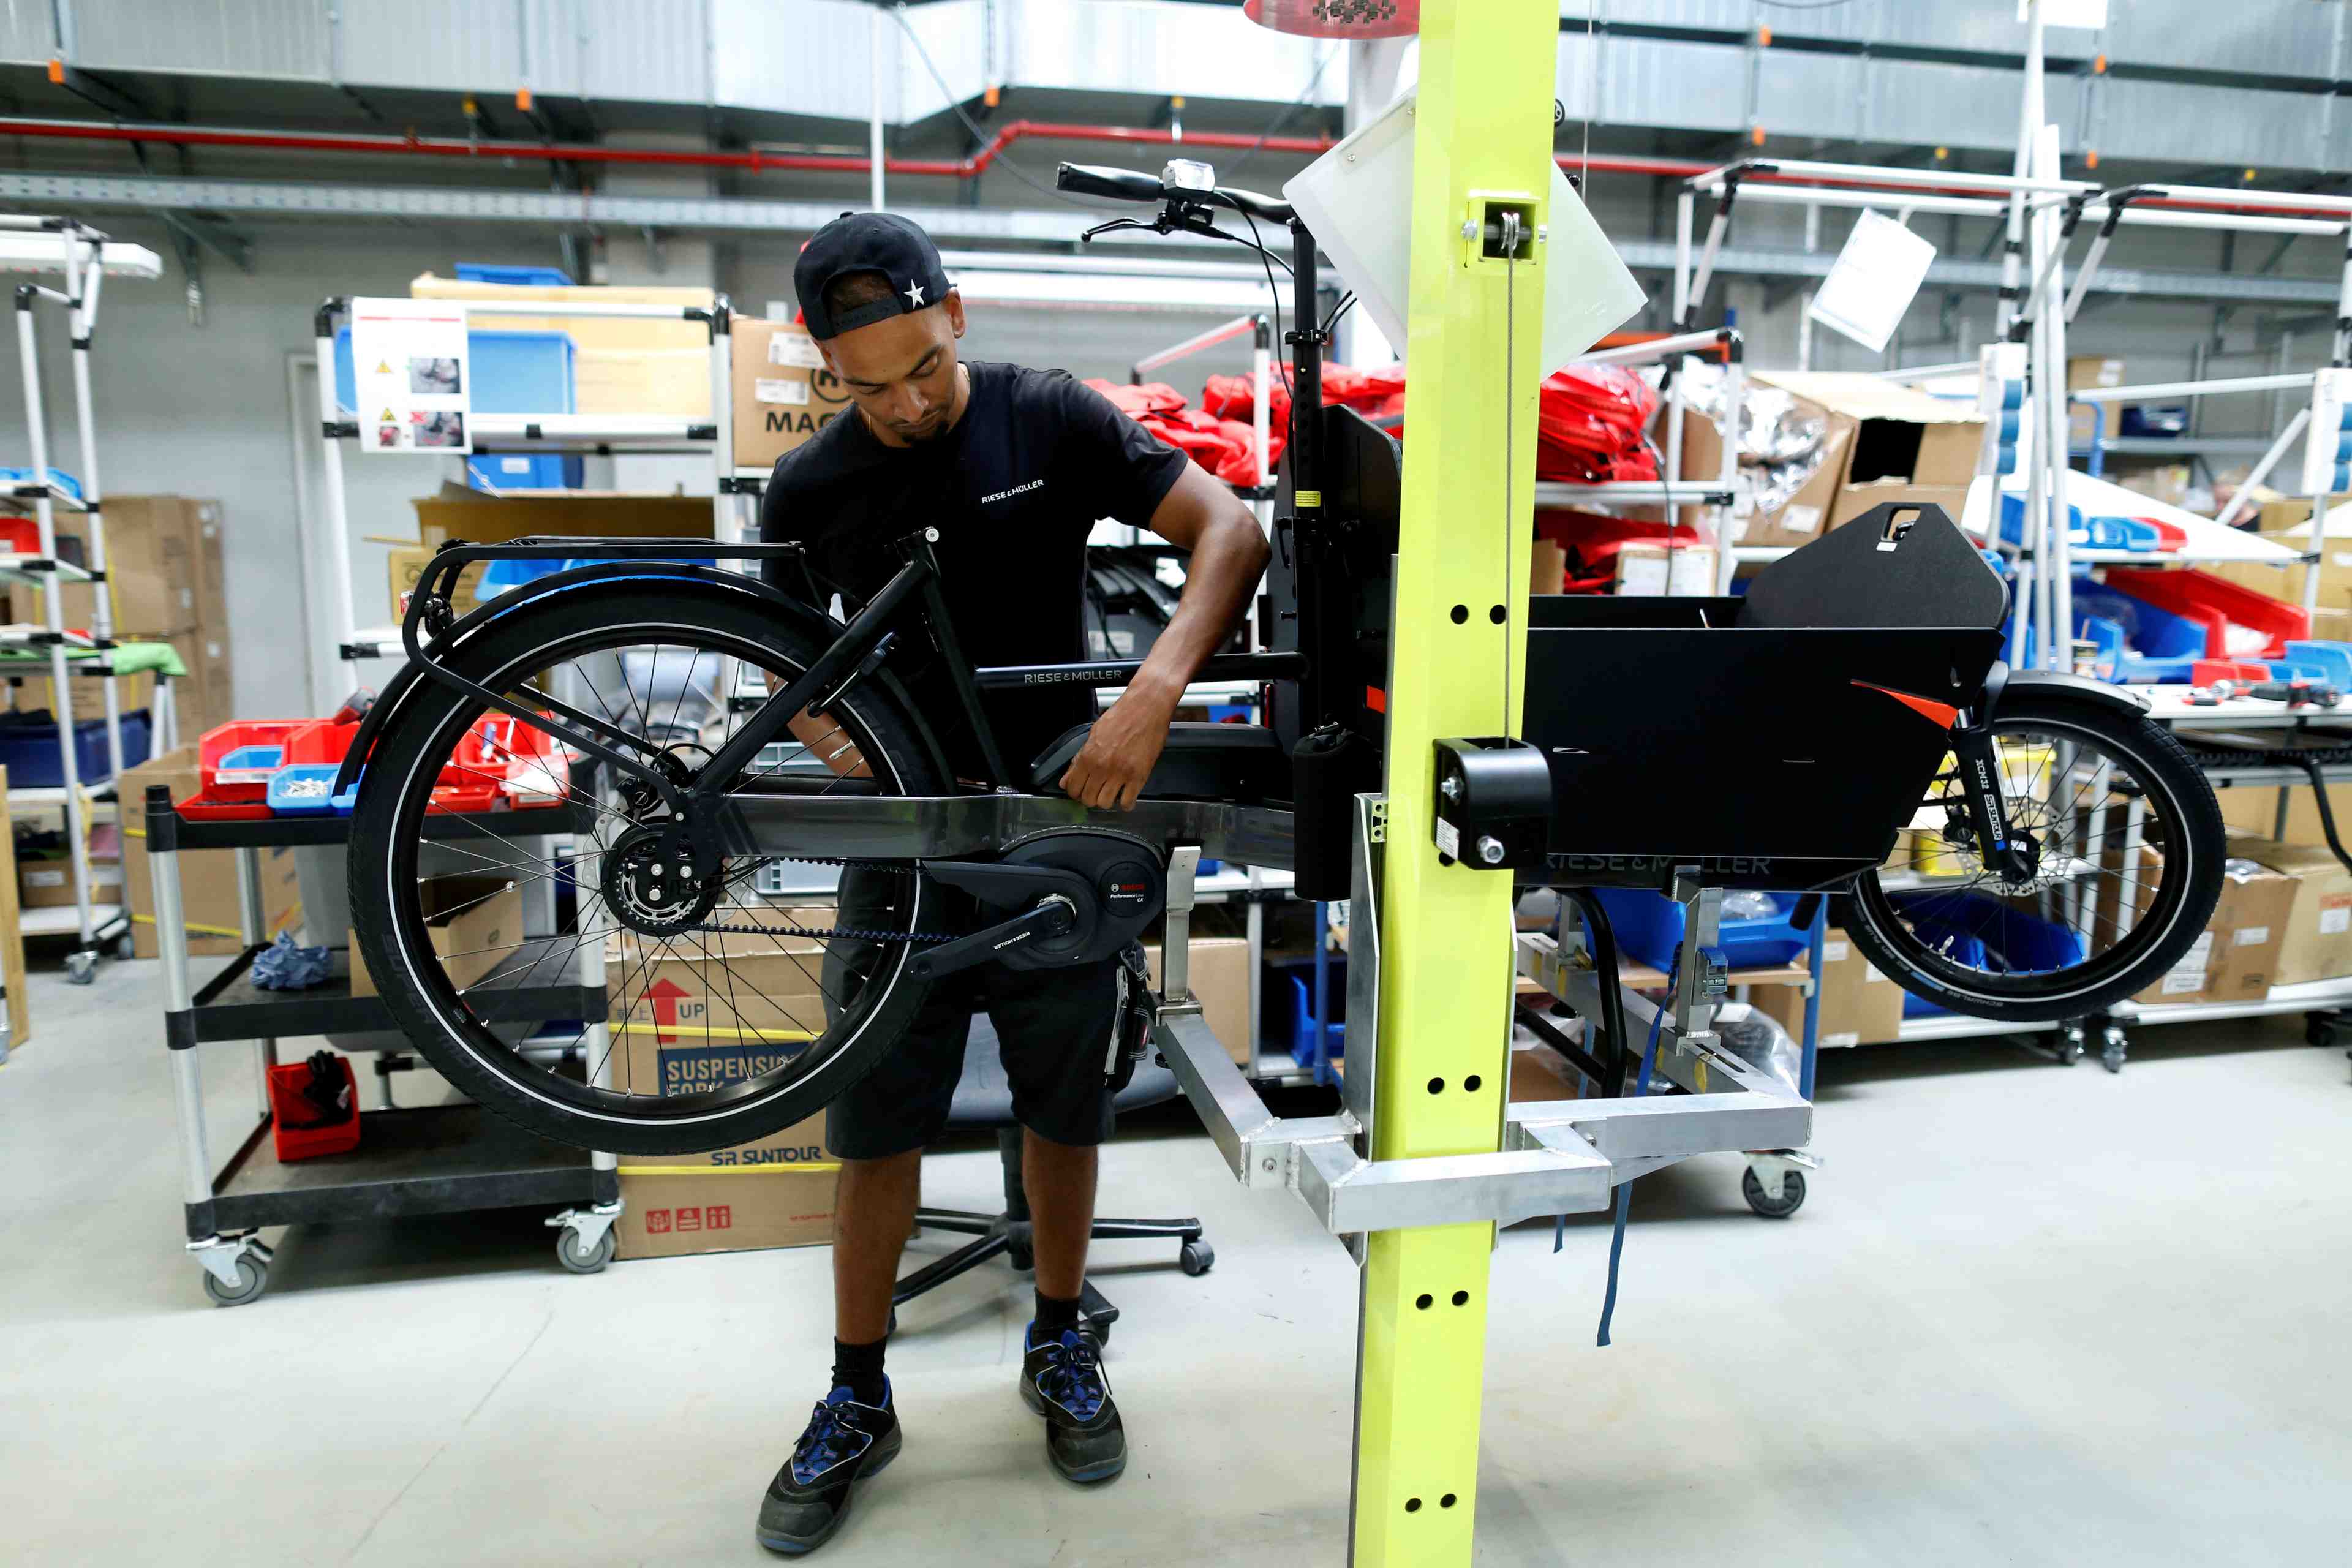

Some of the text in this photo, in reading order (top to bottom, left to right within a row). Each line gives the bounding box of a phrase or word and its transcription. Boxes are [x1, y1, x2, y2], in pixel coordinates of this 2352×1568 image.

[679, 1003, 705, 1019] UP
[666, 1055, 794, 1082] SUSPENSI
[710, 1146, 823, 1166] SR SUNTOUR
